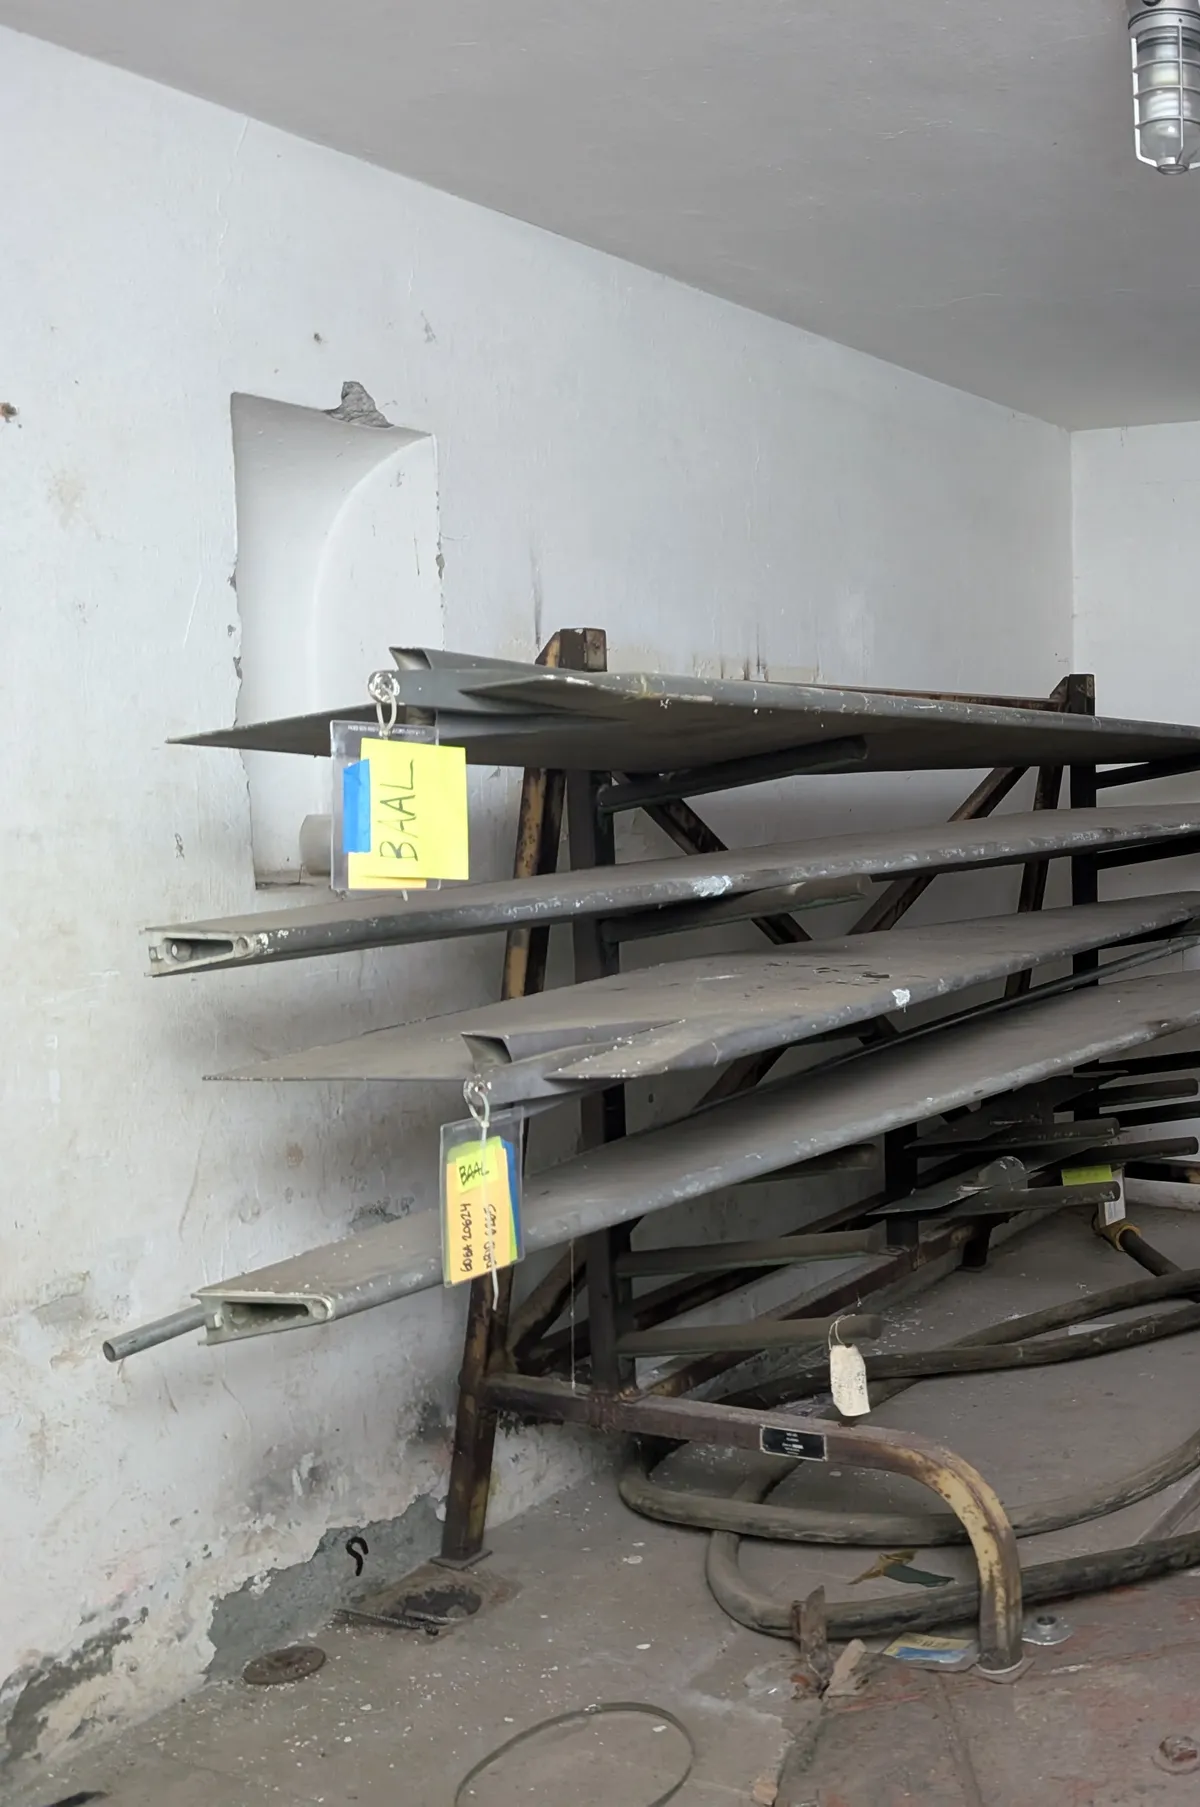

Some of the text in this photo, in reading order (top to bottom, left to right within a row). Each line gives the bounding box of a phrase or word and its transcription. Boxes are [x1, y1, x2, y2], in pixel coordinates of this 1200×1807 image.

[377, 758, 419, 862] BAAL
[459, 1161, 489, 1185] BAAL
[460, 1202, 472, 1241] 20624
